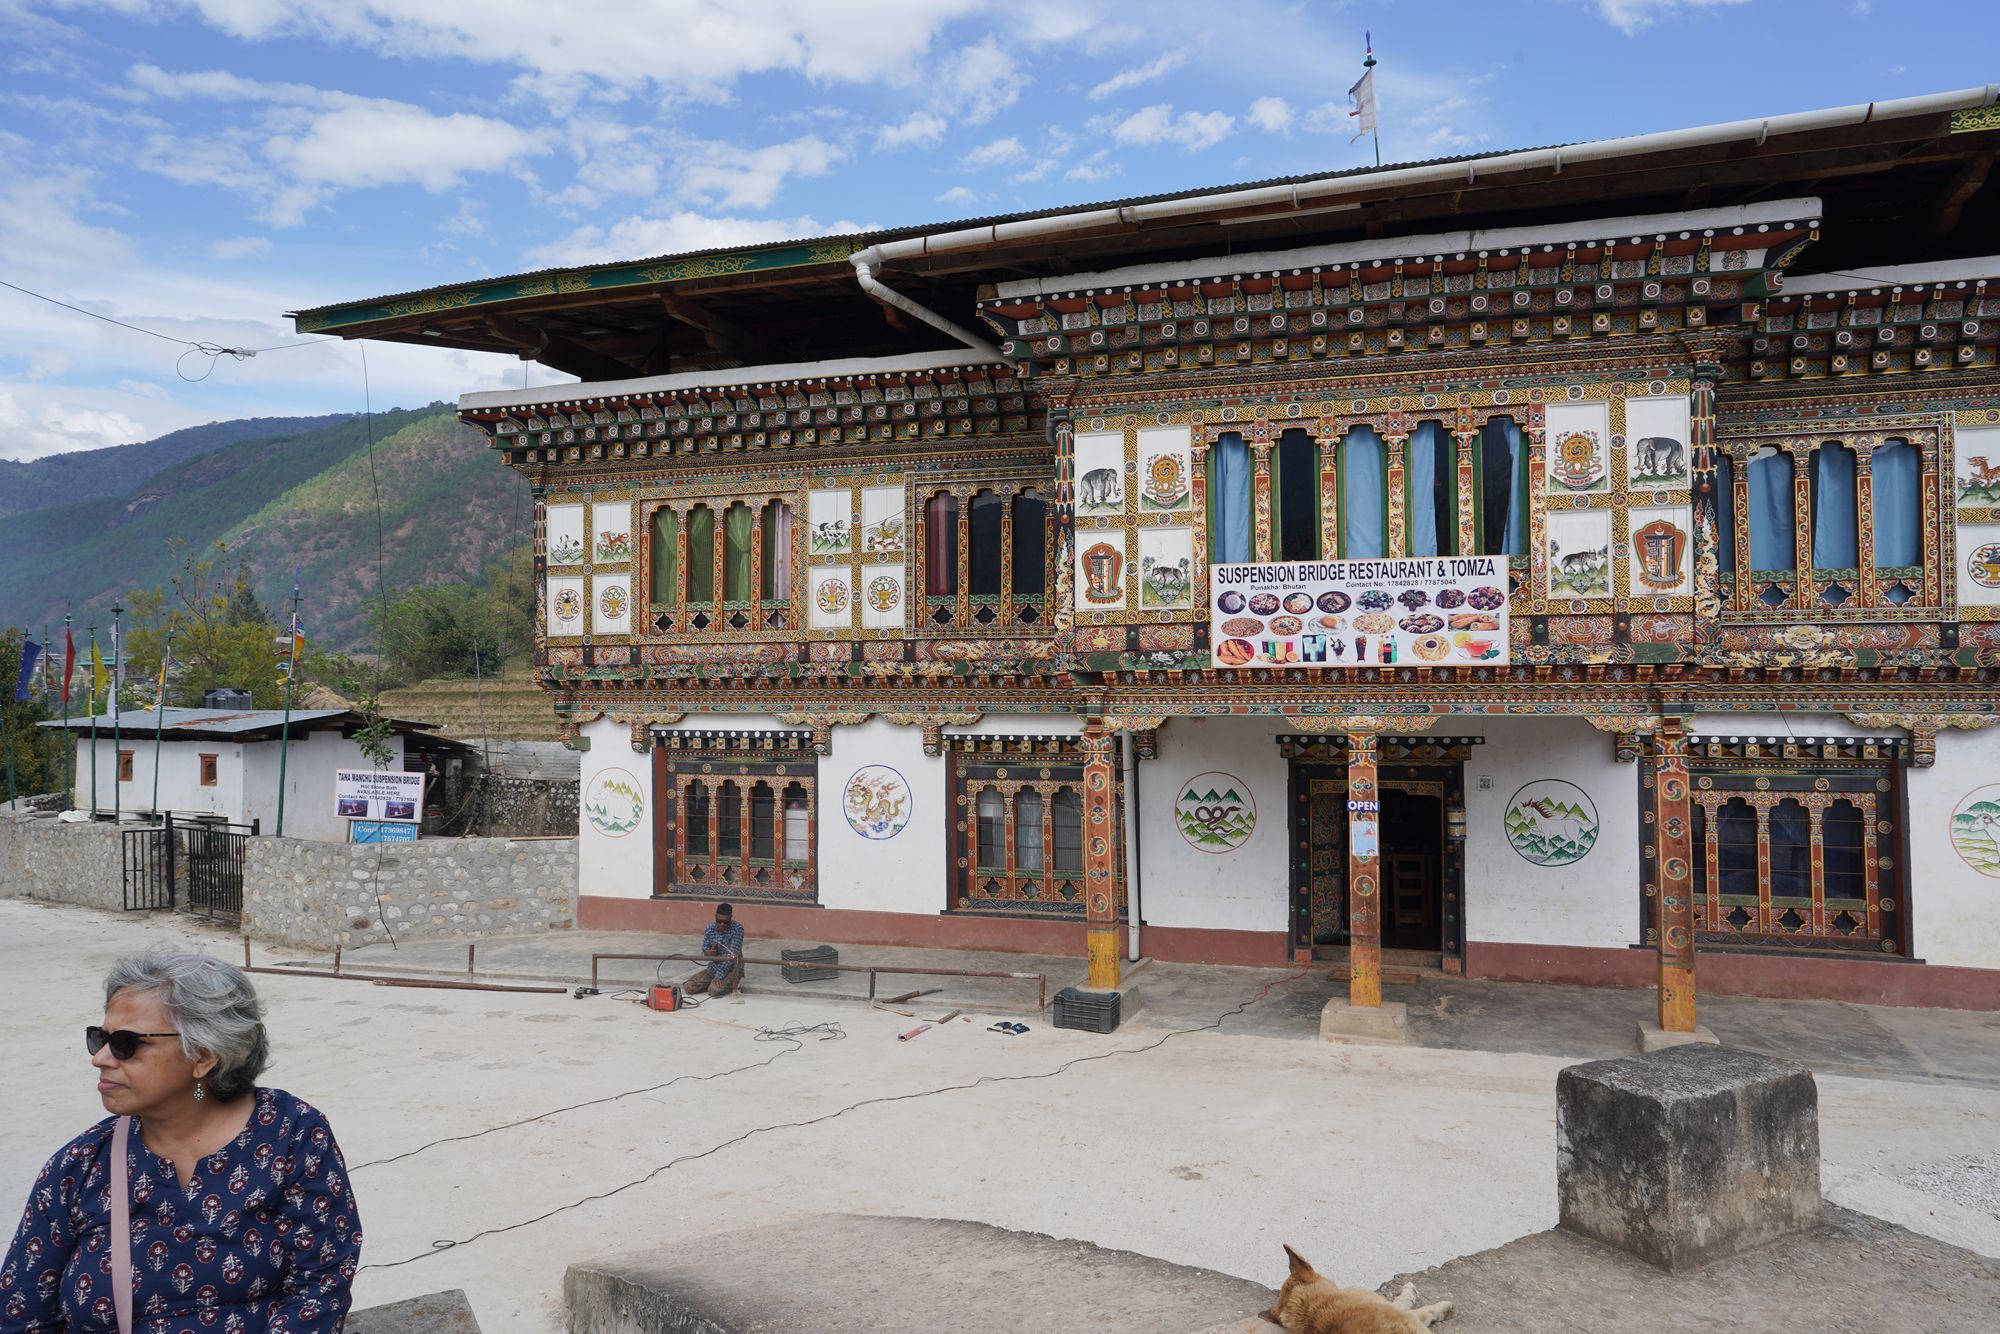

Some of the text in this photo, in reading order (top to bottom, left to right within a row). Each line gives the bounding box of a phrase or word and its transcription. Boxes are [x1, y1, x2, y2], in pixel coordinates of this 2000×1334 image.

[1218, 558, 1495, 584] SUSPENSION BRIDGE RESTAURANT & TOMZA
[338, 773, 420, 785] TANA MANCHU SUSPENSION BRIDGE
[1348, 801, 1378, 811] OPEN
